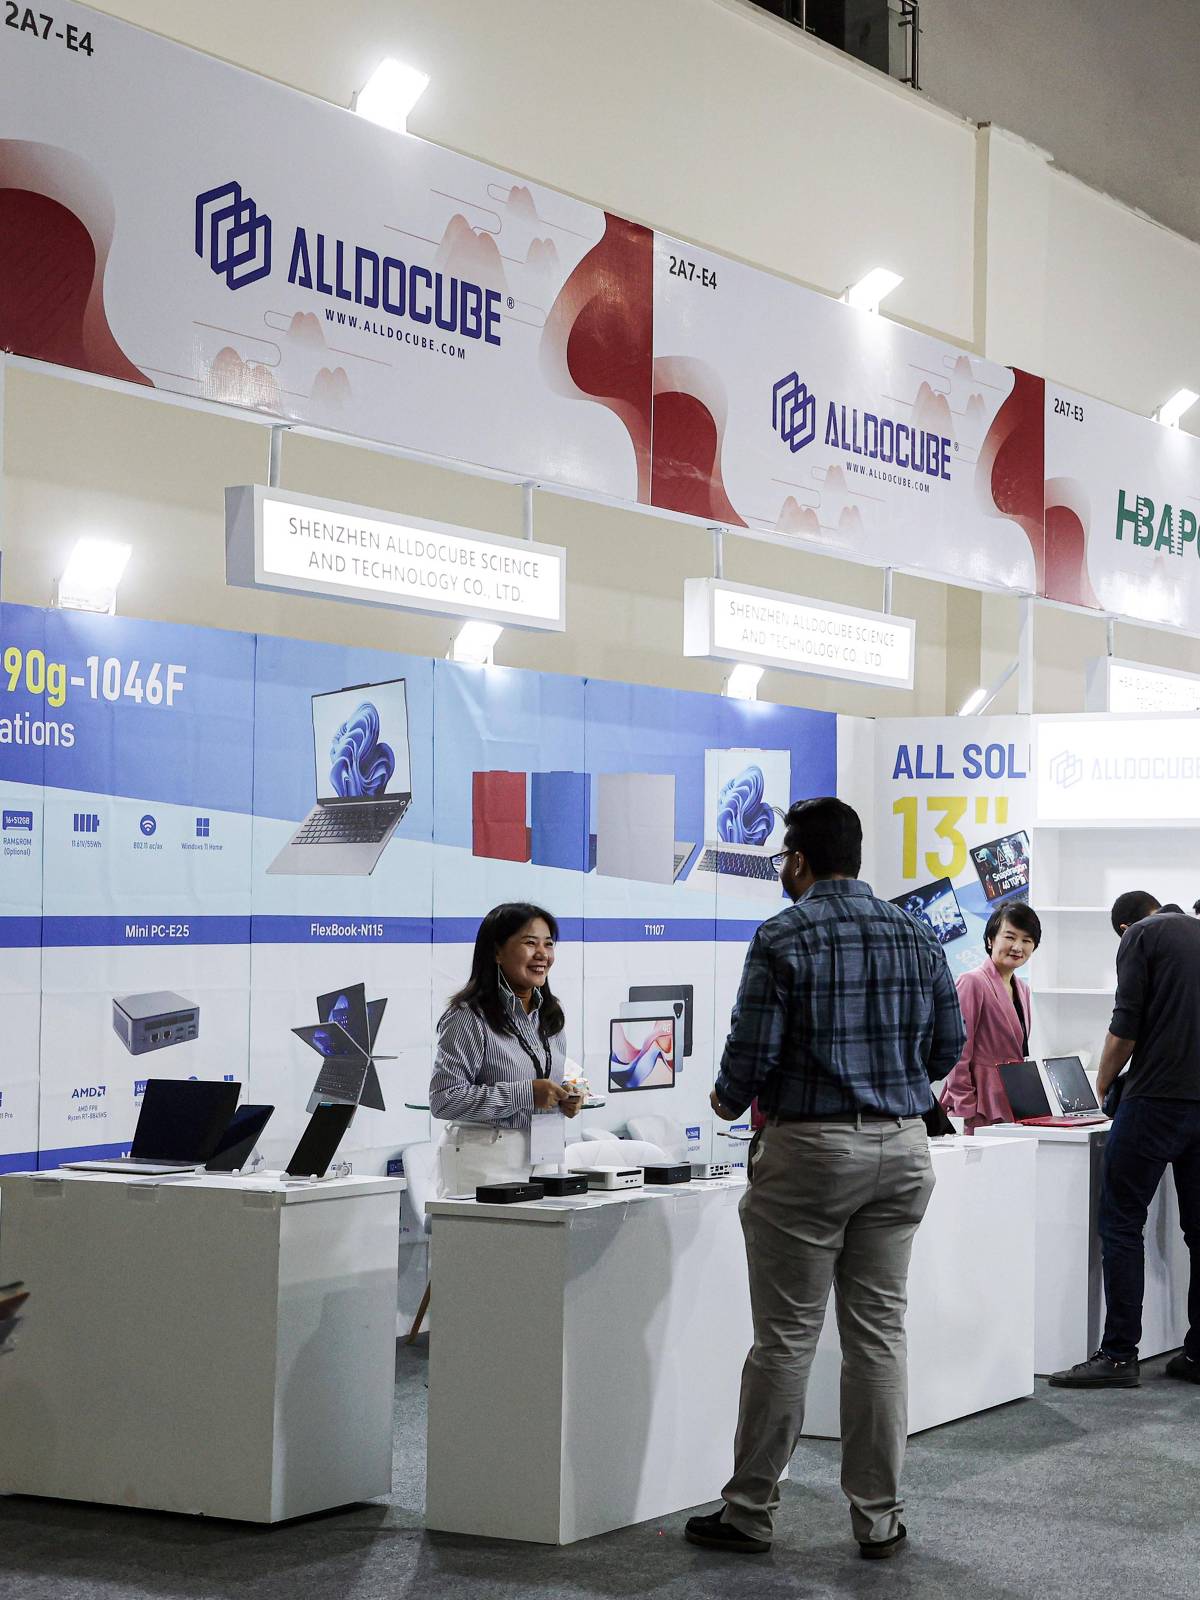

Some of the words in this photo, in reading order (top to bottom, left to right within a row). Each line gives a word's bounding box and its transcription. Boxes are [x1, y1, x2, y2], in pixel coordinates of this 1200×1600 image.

[4, 1, 94, 57] 2A7-E4
[288, 227, 501, 346] ALLDOCUBE
[669, 255, 717, 290] 2A7-E4
[325, 308, 466, 360] WWW.ALLDOCUBE.COM
[1054, 398, 1084, 422] 2A7-E3
[824, 401, 951, 480] ALLDOCUBE
[846, 461, 930, 493] WWW.ALLDOCUBE.COM
[289, 517, 380, 550] SHENZHEN
[386, 535, 476, 567] ALLDOCUBE
[481, 553, 539, 578] SCIENCE
[309, 552, 346, 572] AND
[352, 558, 458, 591] TECHNOLOGY
[730, 600, 789, 626] SHENZHEN
[793, 613, 852, 639] ALLDOCUBE
[856, 626, 895, 647] SCIENCE
[742, 629, 765, 645] AND
[771, 633, 840, 658] TECHNOLOGY
[0, 647, 187, 707] 90g-1046F
[892, 744, 955, 780] ALL
[963, 743, 1031, 780] SOL
[125, 925, 149, 938] Mini
[151, 925, 190, 937] PC-E25
[310, 923, 384, 937] FlexBook-N115
[644, 925, 665, 936] T1107
[72, 1087, 97, 1098] AMD
